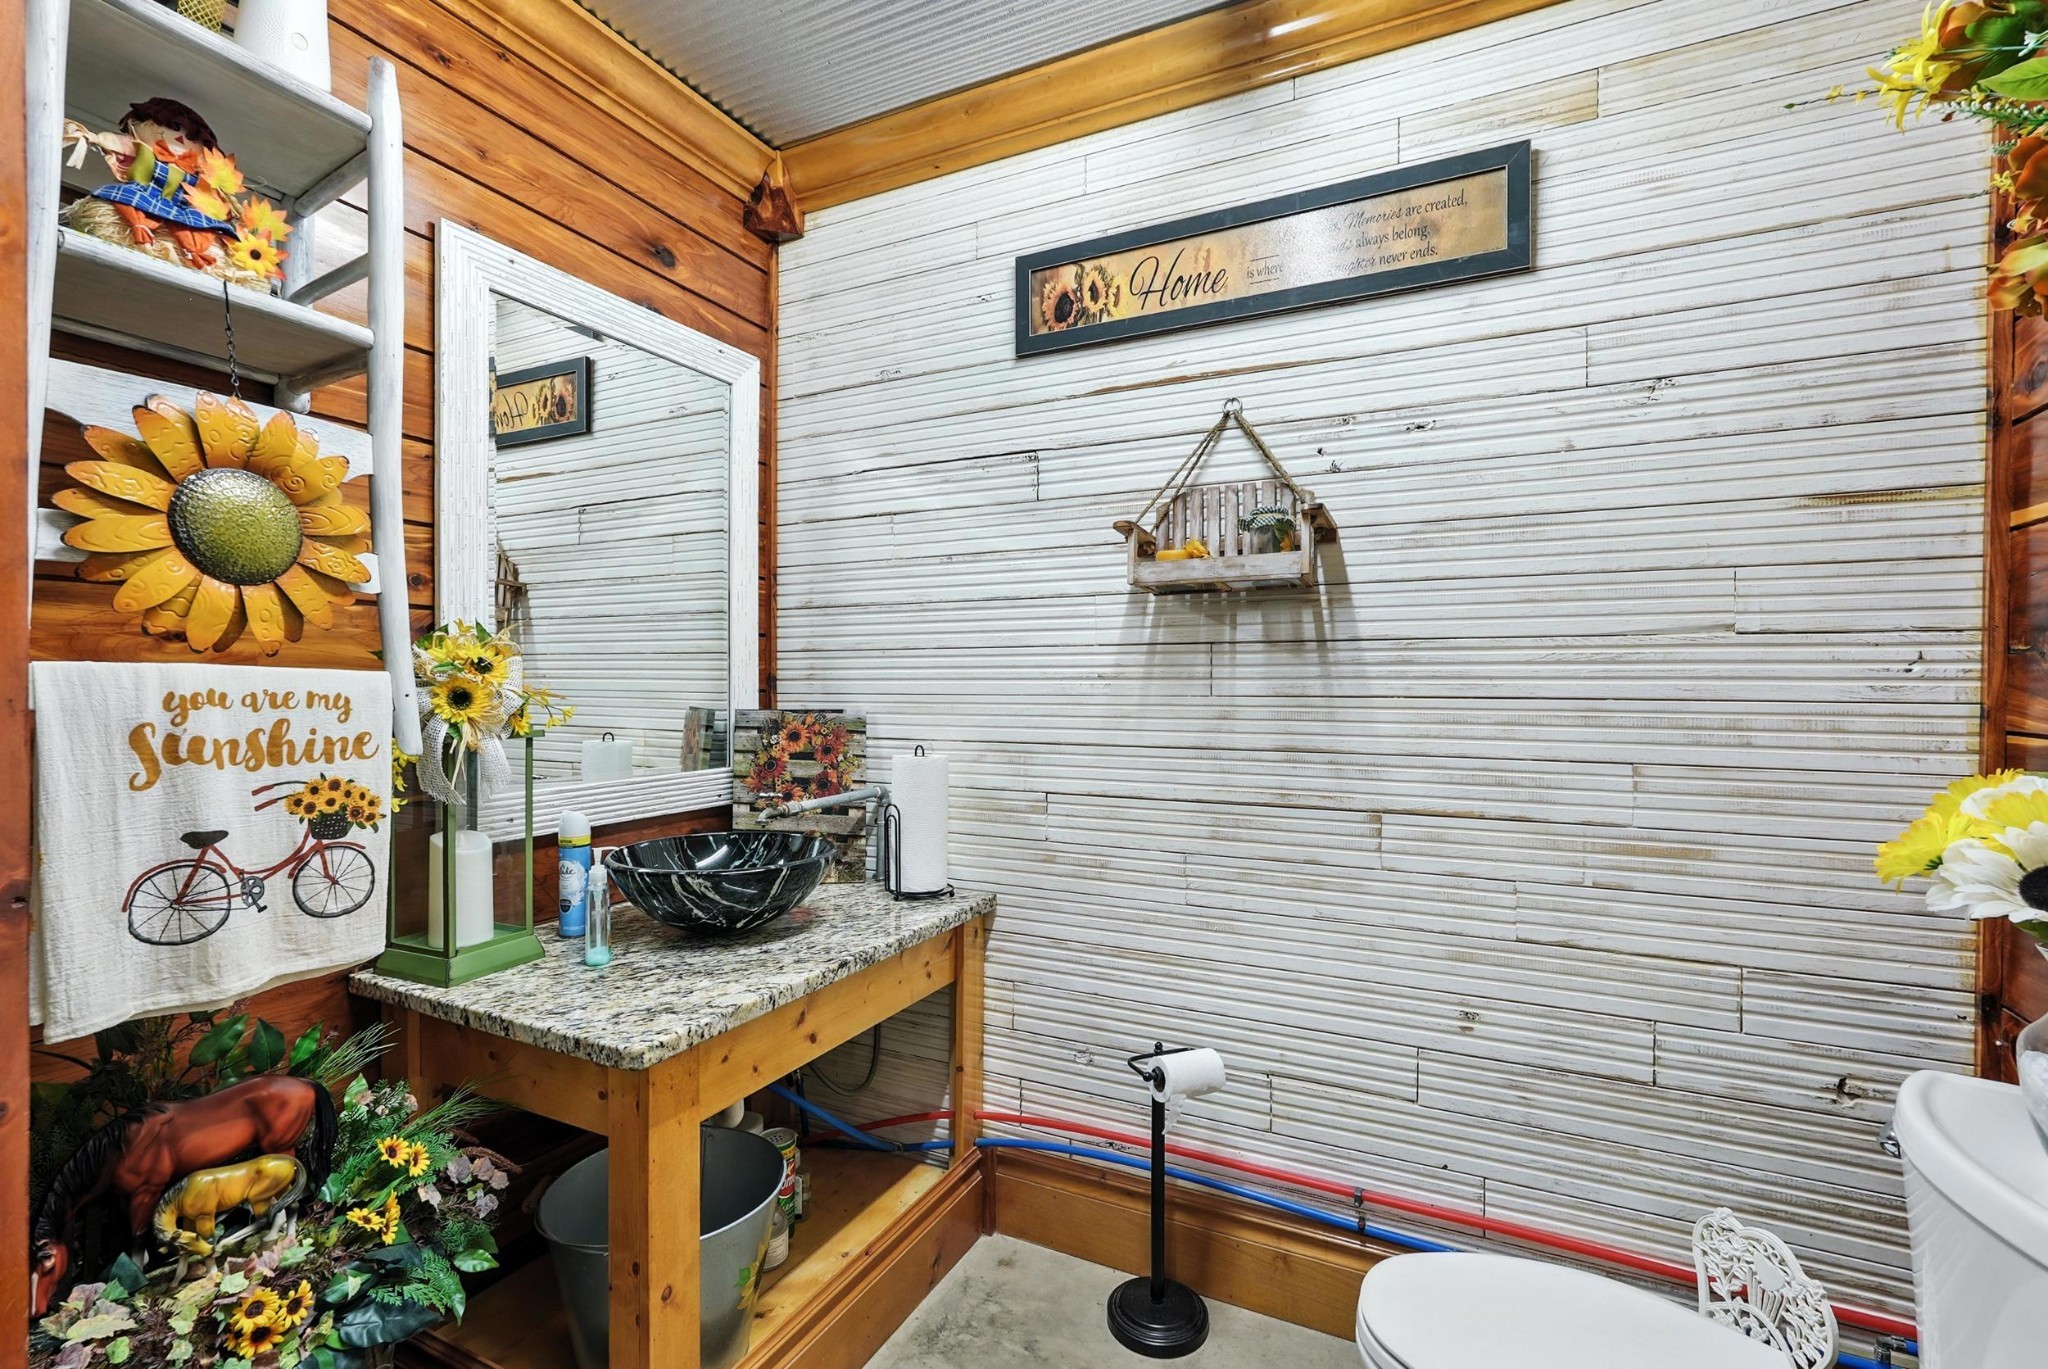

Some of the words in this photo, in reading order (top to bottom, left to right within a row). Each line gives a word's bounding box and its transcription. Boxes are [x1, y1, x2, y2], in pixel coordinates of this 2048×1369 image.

[1345, 208, 1403, 229] Memories
[1406, 203, 1423, 217] are
[1425, 188, 1468, 213] created,
[1355, 231, 1389, 250] always
[1379, 250, 1408, 265] never
[1410, 240, 1439, 259] ends.
[1129, 248, 1229, 310] Home
[1246, 265, 1255, 279] is
[1256, 259, 1285, 277] where
[162, 688, 233, 727] you
[241, 689, 299, 713] are
[306, 690, 353, 723] my
[128, 718, 380, 792] Sunshine
